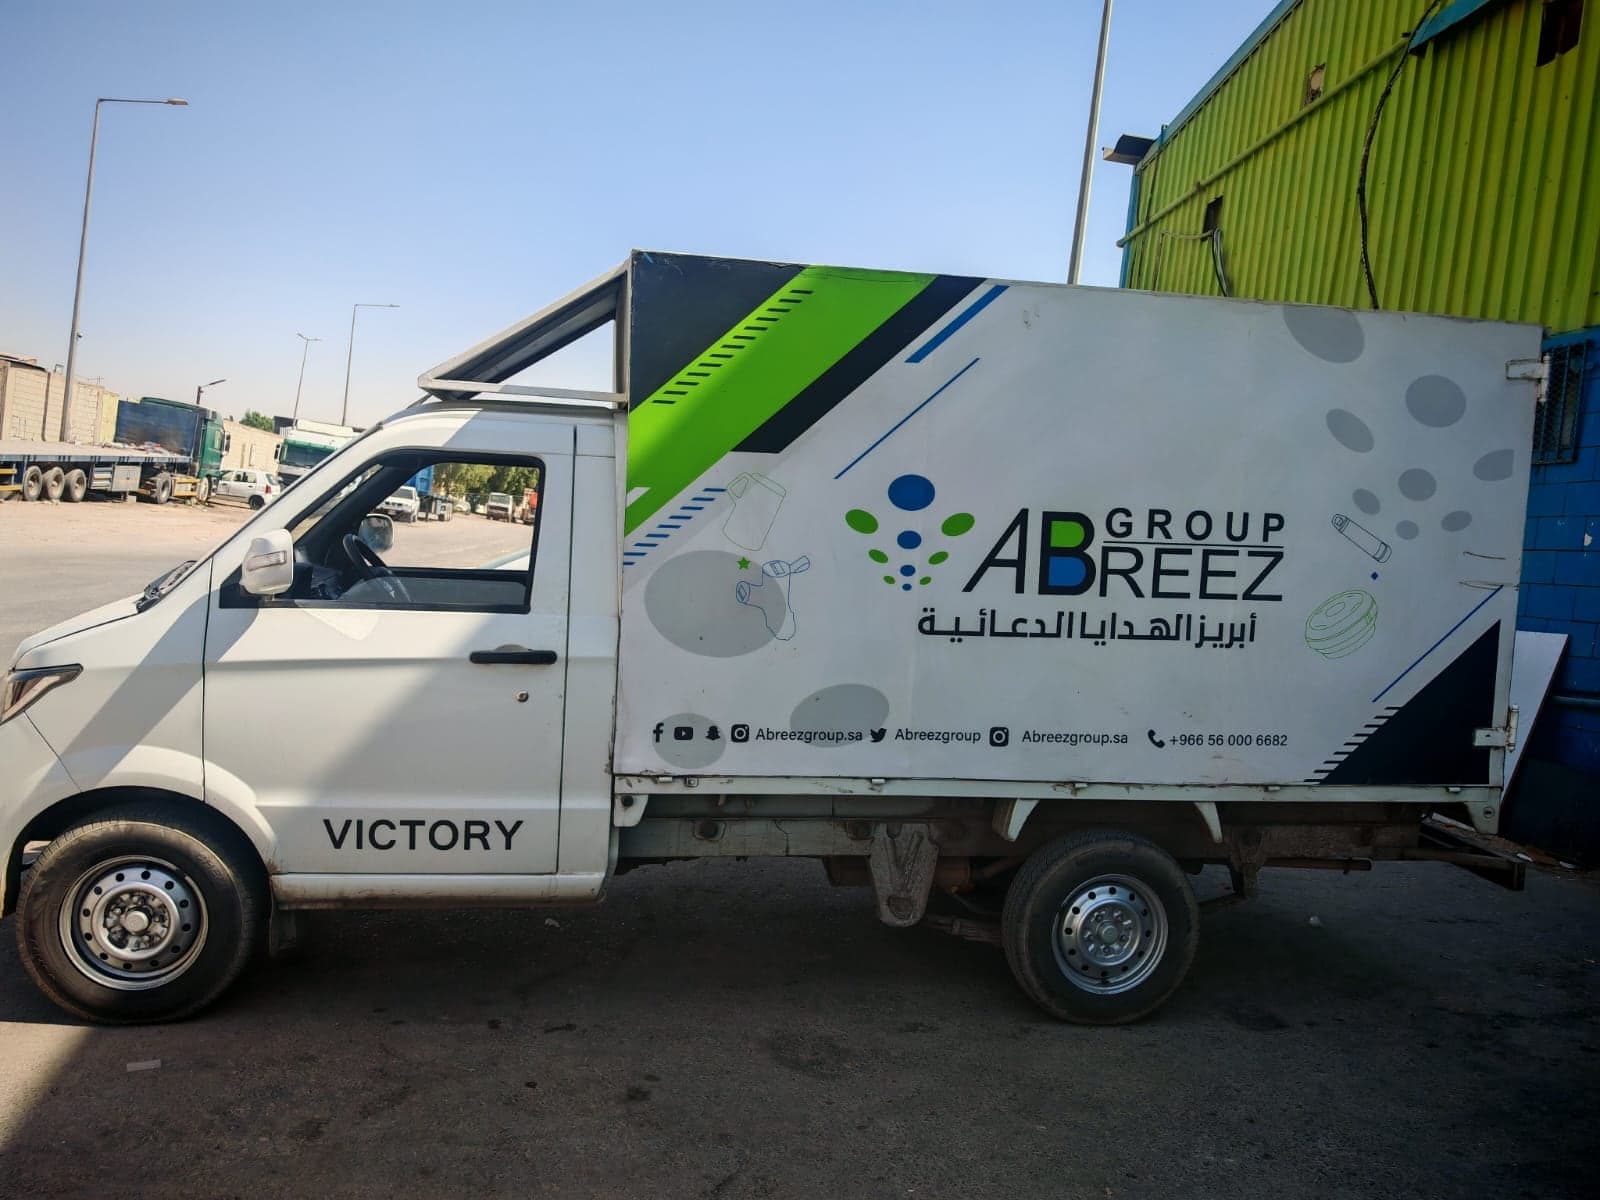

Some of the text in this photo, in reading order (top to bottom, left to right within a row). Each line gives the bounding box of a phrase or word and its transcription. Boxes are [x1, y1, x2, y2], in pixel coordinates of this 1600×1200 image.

[1105, 507, 1285, 543] GROUP
[961, 507, 1285, 602] ABREEZ
[917, 607, 1257, 649] أبريز الهدايا الدعائية
[755, 727, 863, 744] Abreezgroup.sa
[894, 727, 982, 744] Abreezgroup
[1021, 729, 1129, 746] Abreezgroup.sa
[1169, 734, 1204, 747] +966
[1207, 734, 1225, 747] 56
[1227, 734, 1254, 747] 000
[1255, 734, 1288, 747] 6682
[322, 818, 524, 851] VICTORY
